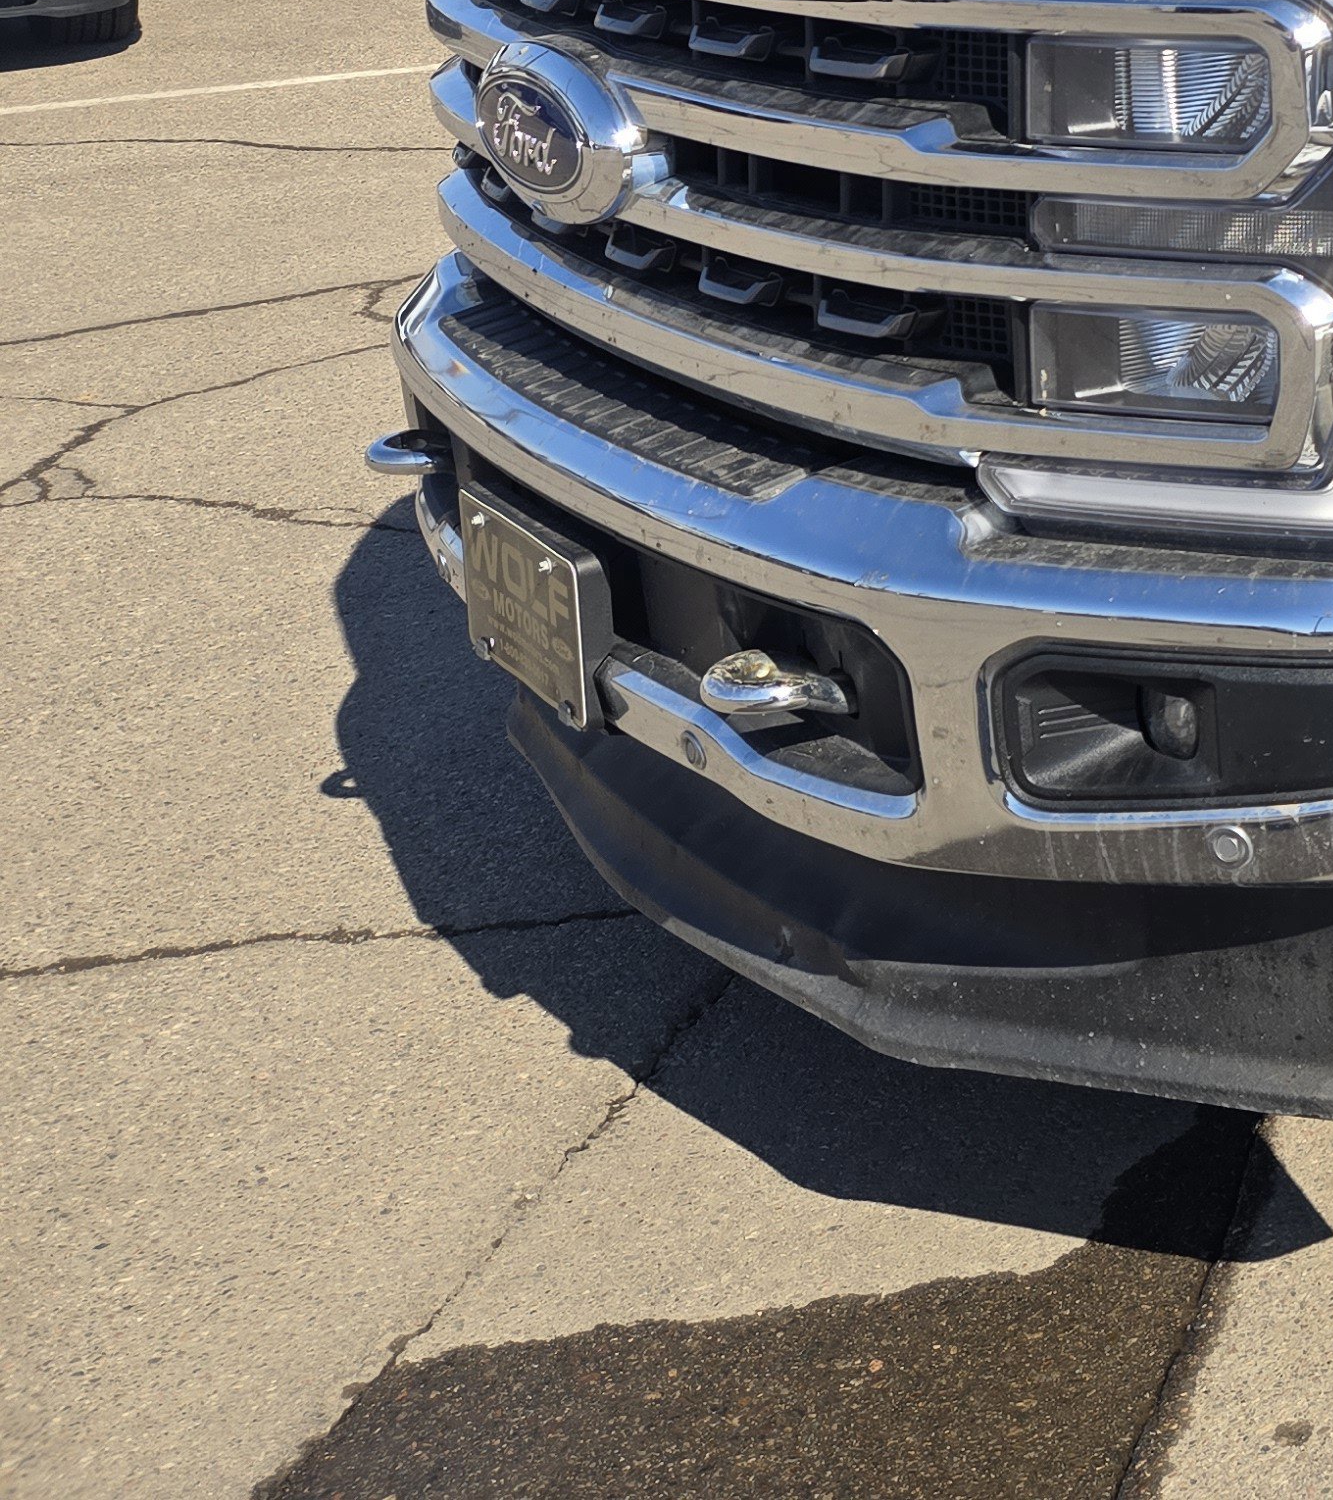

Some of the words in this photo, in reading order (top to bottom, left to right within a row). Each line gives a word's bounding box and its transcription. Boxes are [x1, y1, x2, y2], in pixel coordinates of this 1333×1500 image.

[494, 91, 557, 175] Ford
[464, 514, 570, 628] WOLF
[493, 589, 549, 650] MOTORS
